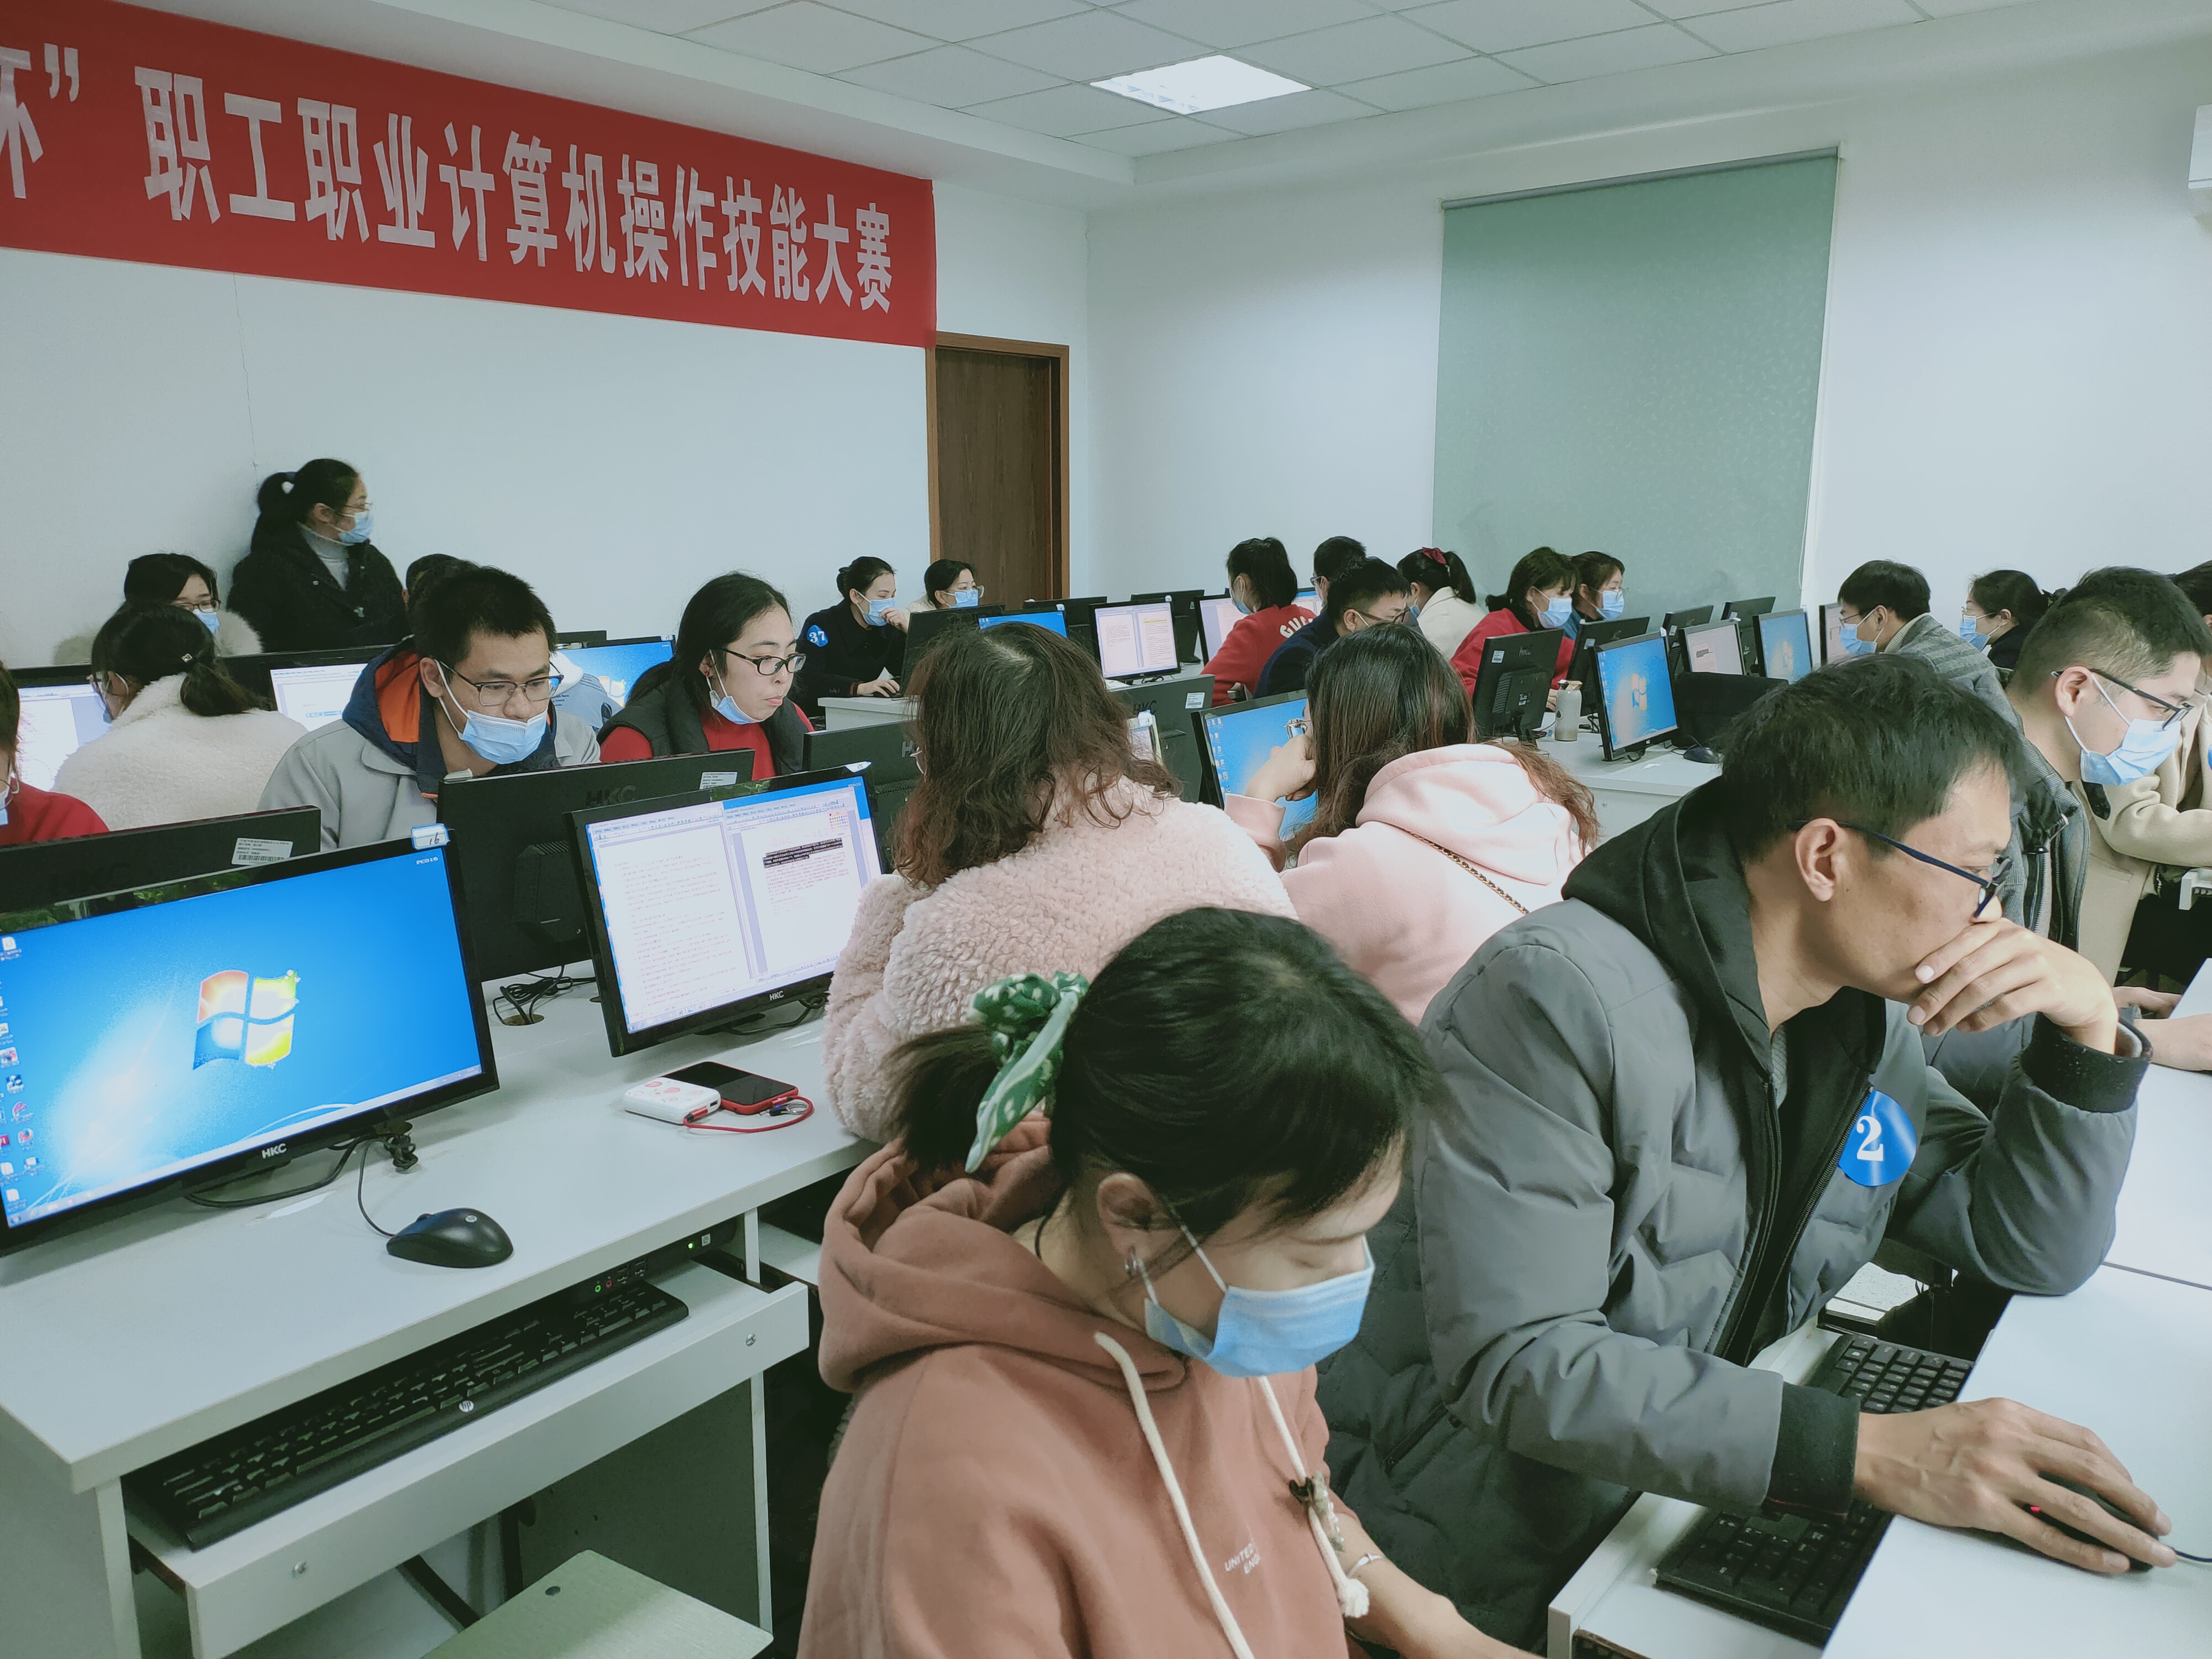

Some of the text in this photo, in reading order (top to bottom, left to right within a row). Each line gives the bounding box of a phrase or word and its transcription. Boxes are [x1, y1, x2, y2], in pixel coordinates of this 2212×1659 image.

[809, 630, 825, 643] 37
[429, 832, 440, 845] 16
[769, 990, 784, 1001] HKC
[1856, 1115, 1884, 1161] 2
[262, 1142, 287, 1159] HKC
[1224, 1542, 1255, 1572] UNITED
